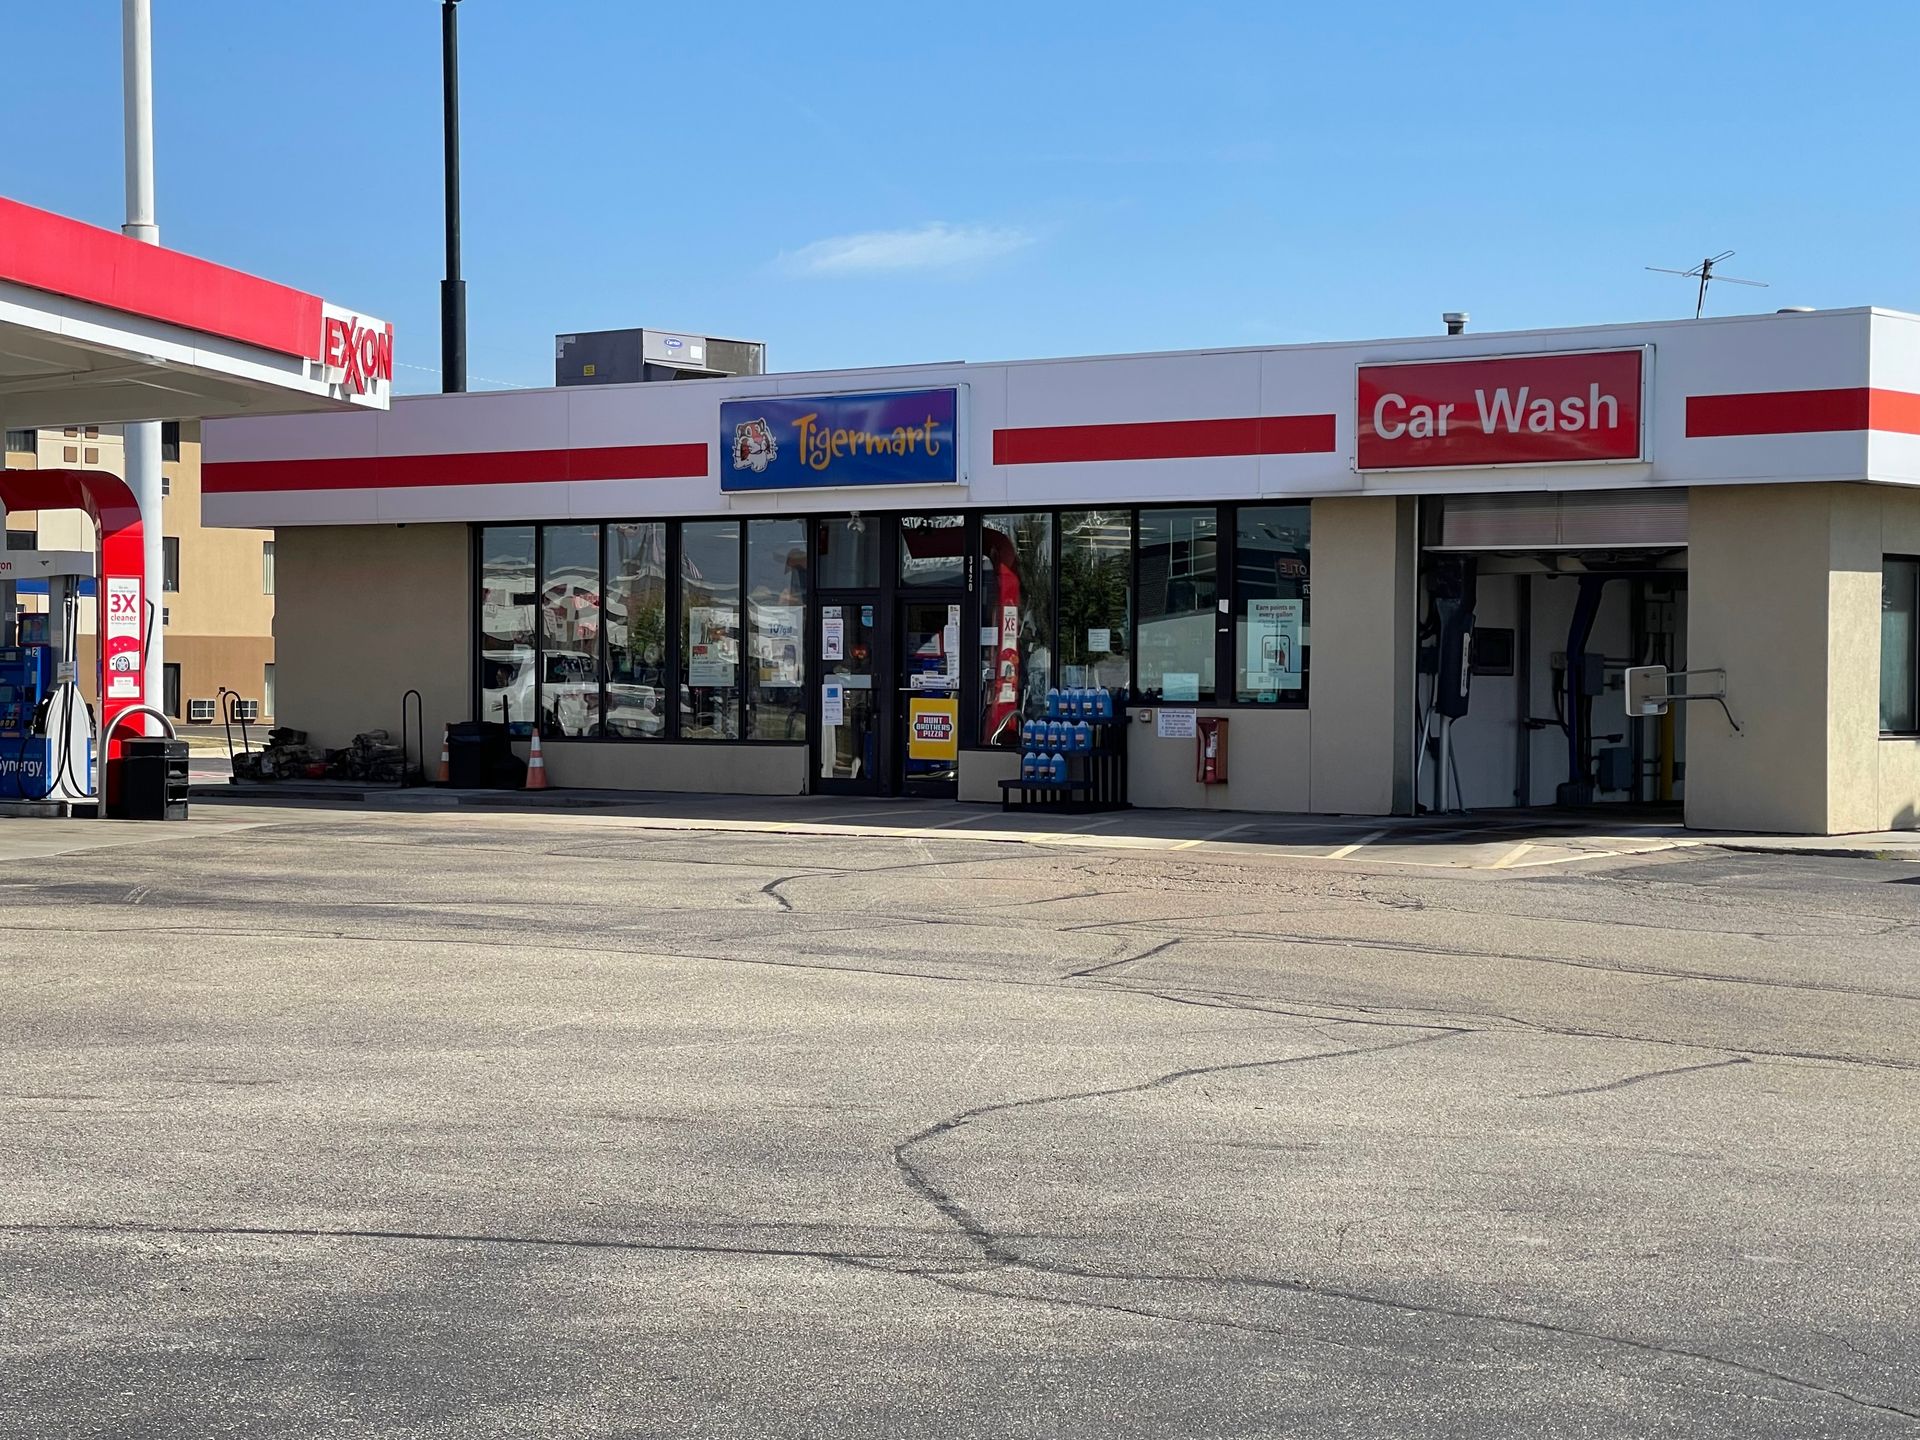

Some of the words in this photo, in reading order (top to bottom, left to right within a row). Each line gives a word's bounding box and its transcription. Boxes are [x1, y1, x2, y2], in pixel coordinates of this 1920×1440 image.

[325, 316, 393, 395] EXXON
[1373, 393, 1454, 440] Car
[1475, 382, 1618, 434] Wash
[792, 413, 940, 470] Tigermart
[110, 594, 136, 613] 3X
[110, 614, 136, 622] cleaner
